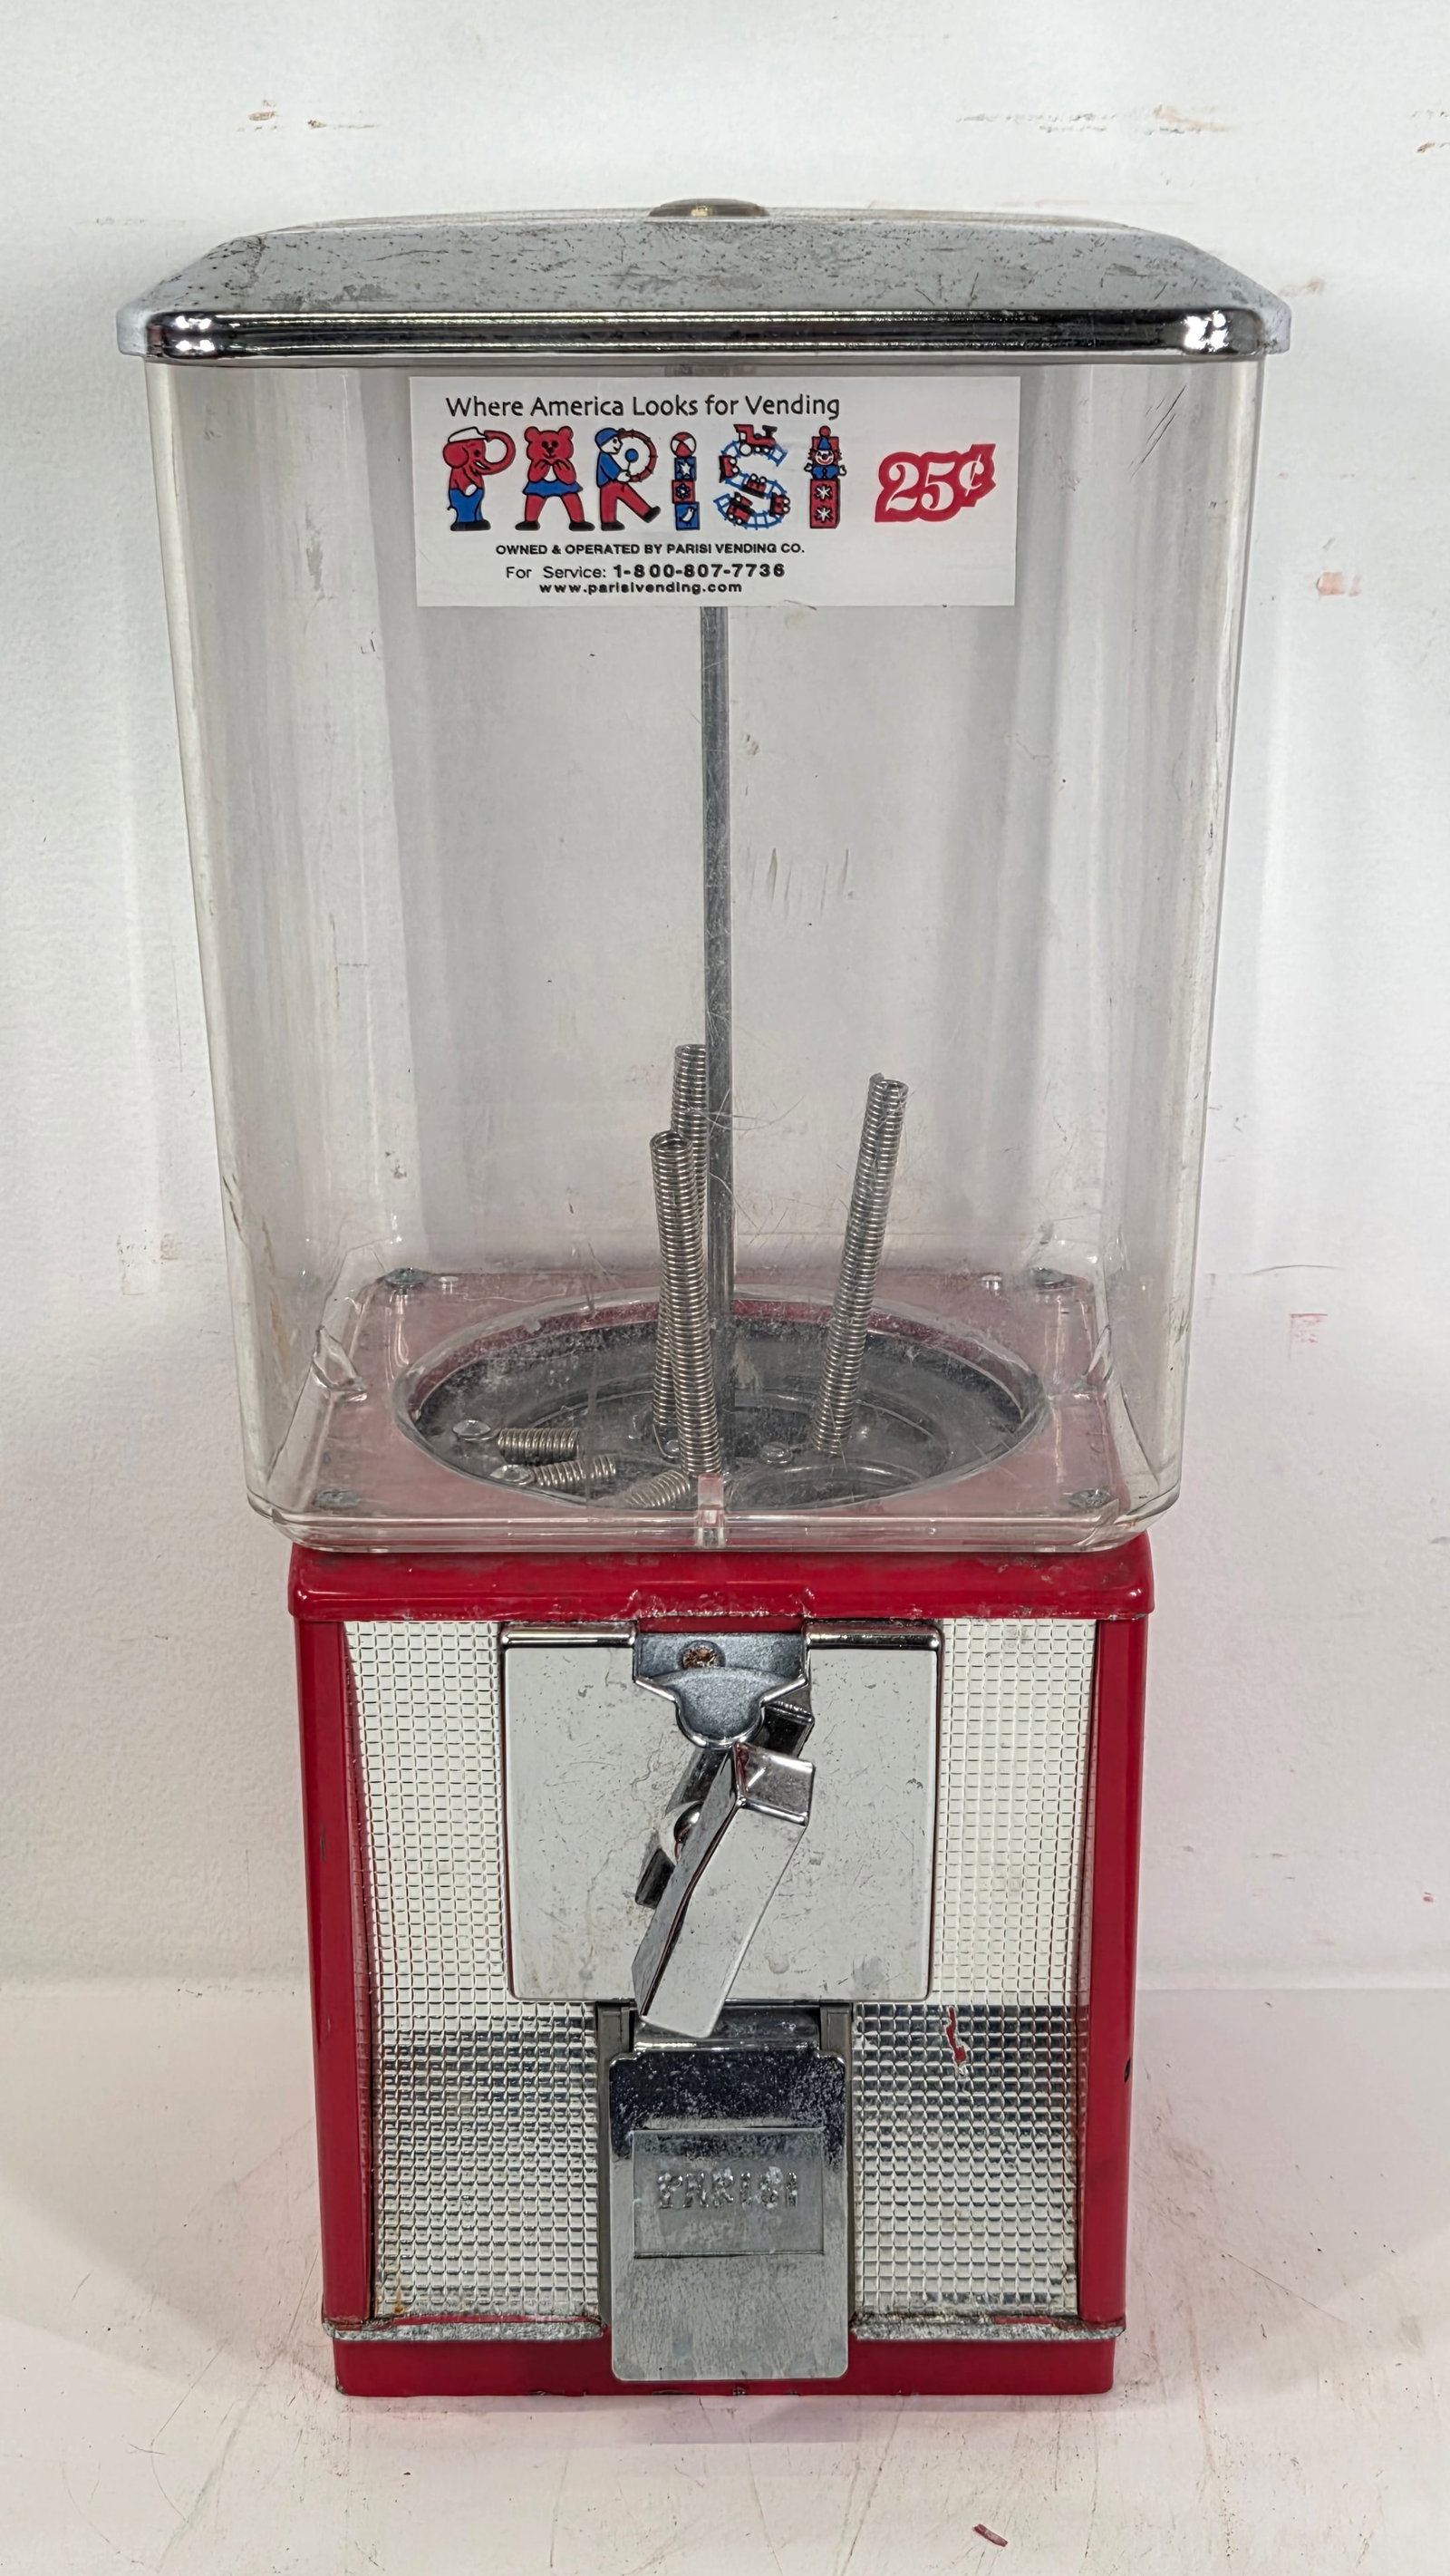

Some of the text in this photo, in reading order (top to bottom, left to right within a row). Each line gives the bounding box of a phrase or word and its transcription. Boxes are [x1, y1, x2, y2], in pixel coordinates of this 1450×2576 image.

[446, 393, 840, 421] Where America Looks for Vending
[882, 451, 987, 514] 25¢
[495, 543, 806, 555] OWNED & OPERATED BY PARISI VENDING CO.
[506, 563, 786, 579] For Service: 1-800-807-7736
[538, 581, 742, 596] www.parisivending.com
